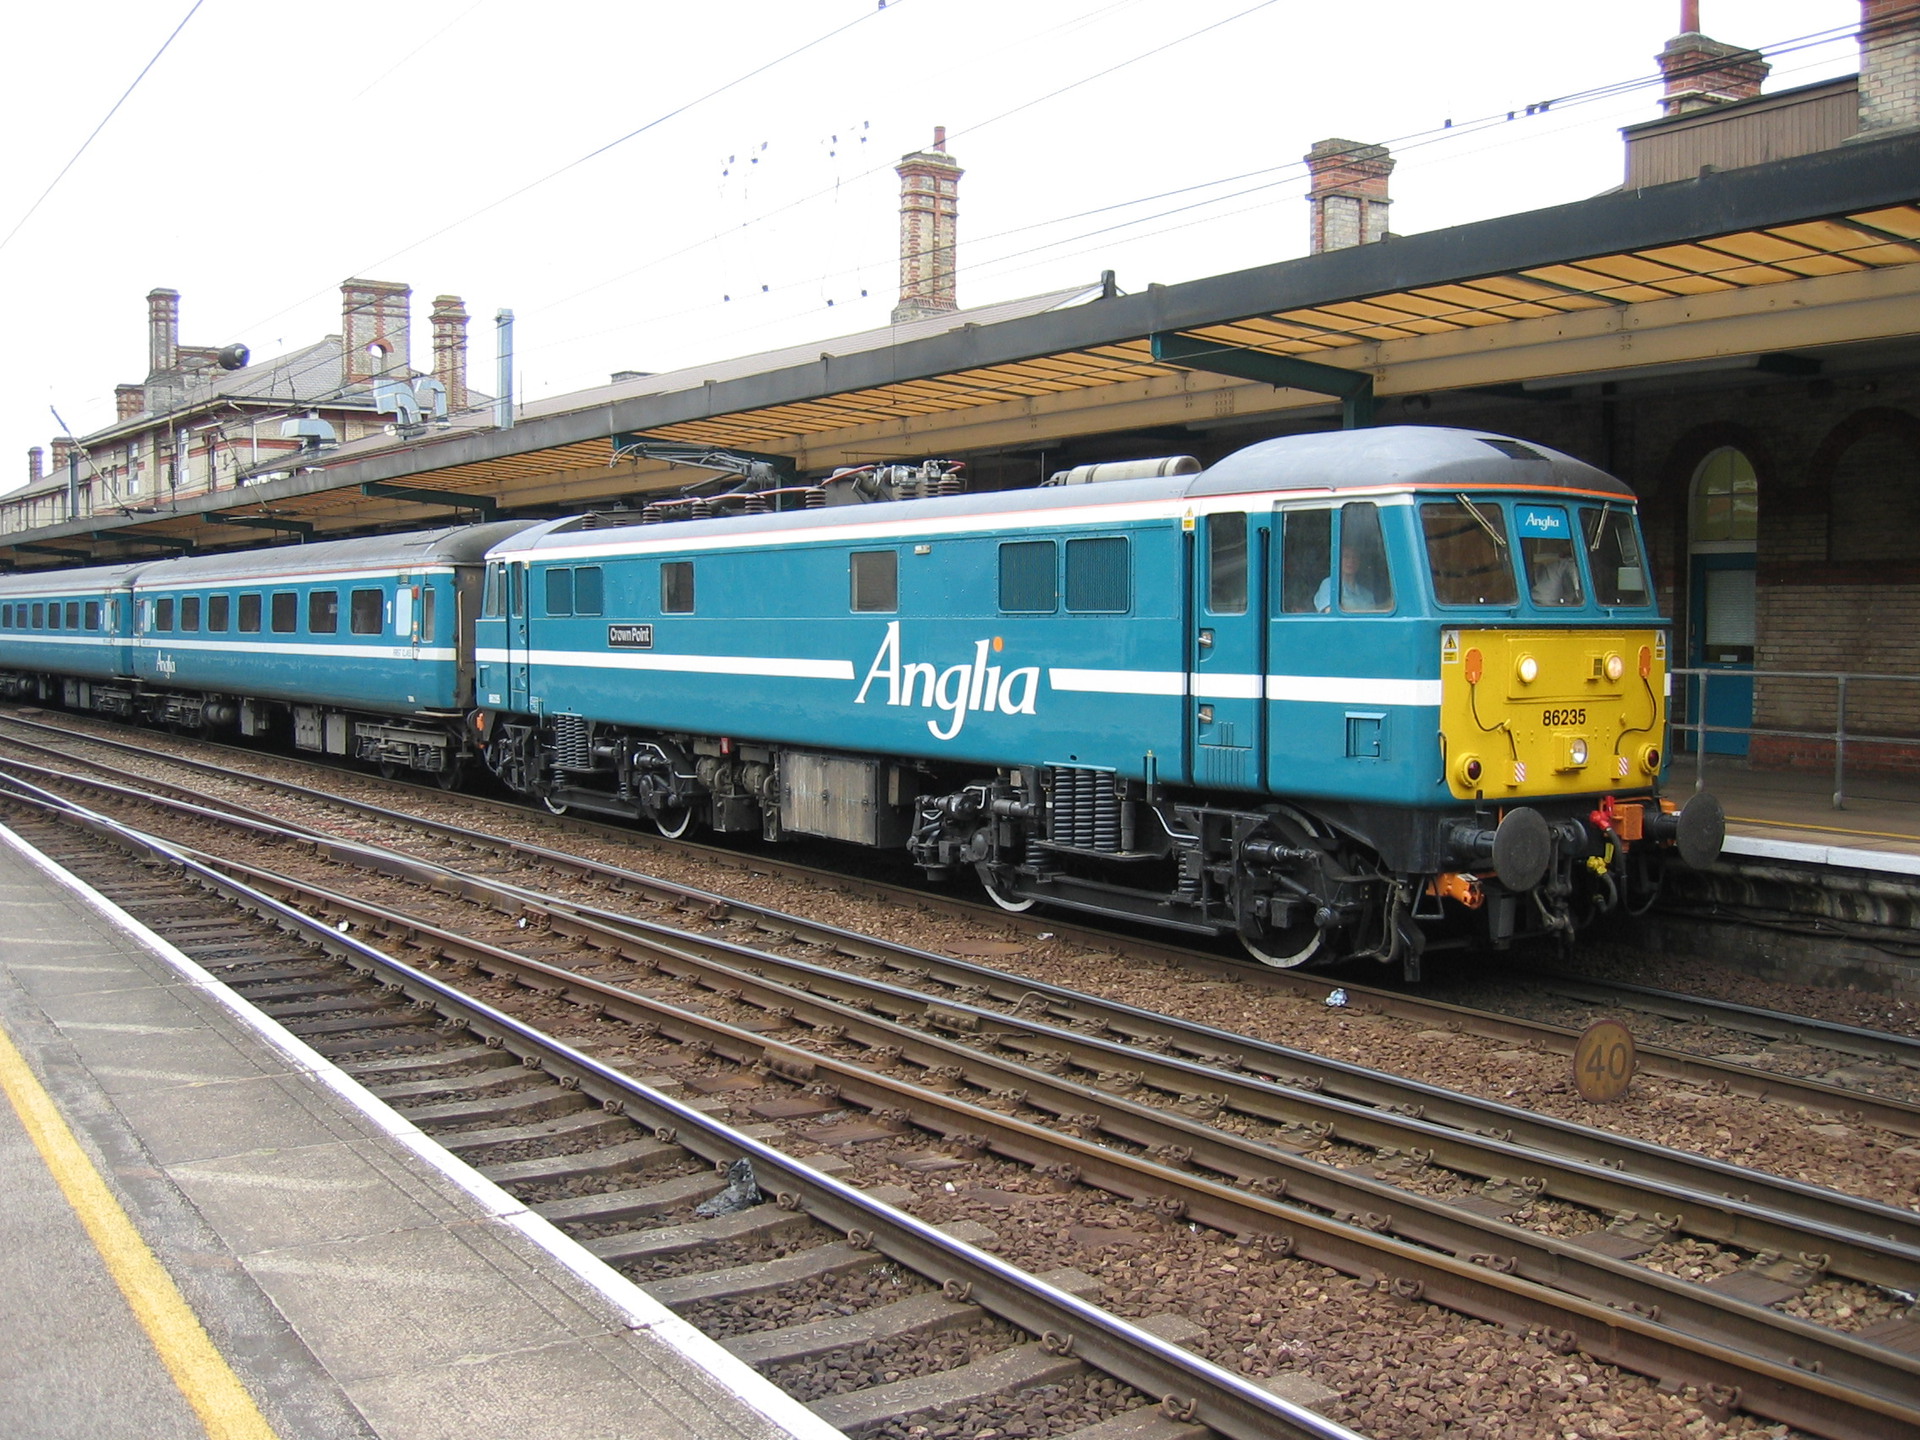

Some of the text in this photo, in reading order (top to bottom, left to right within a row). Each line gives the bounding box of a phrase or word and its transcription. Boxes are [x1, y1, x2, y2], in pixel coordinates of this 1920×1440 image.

[1525, 512, 1560, 531] Anglia
[386, 600, 392, 624] 1
[610, 627, 649, 642] Crown Point
[853, 620, 1041, 741] Anglia
[1542, 708, 1586, 726] 86235
[1586, 1042, 1626, 1081] 40
